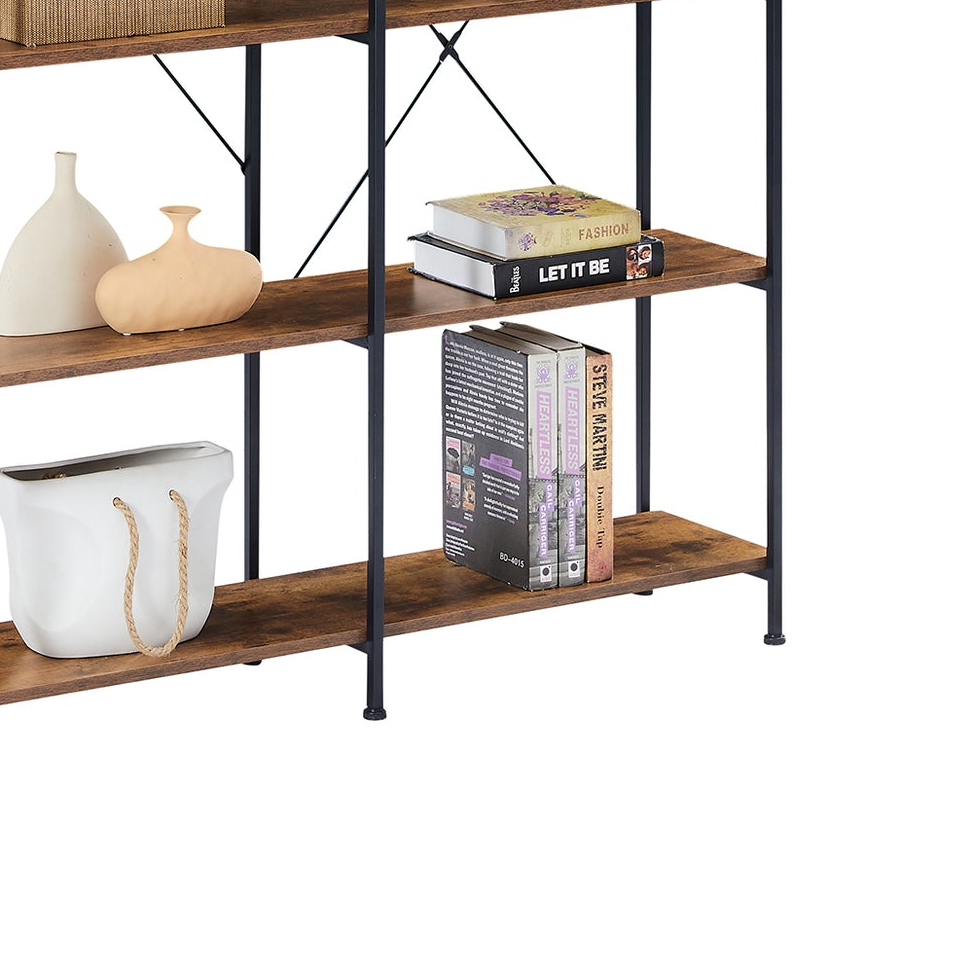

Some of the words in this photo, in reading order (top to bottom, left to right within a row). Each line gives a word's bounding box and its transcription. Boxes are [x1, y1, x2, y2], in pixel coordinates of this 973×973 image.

[578, 222, 629, 240] FASHION
[539, 264, 568, 283] LET
[570, 261, 586, 279] IT
[588, 258, 610, 276] BE
[592, 364, 607, 410] STEVE
[539, 394, 550, 475] HEARTLESS
[568, 388, 579, 470] HEARTLESS
[596, 528, 605, 548] Tap
[499, 552, 525, 568] BD-4015
